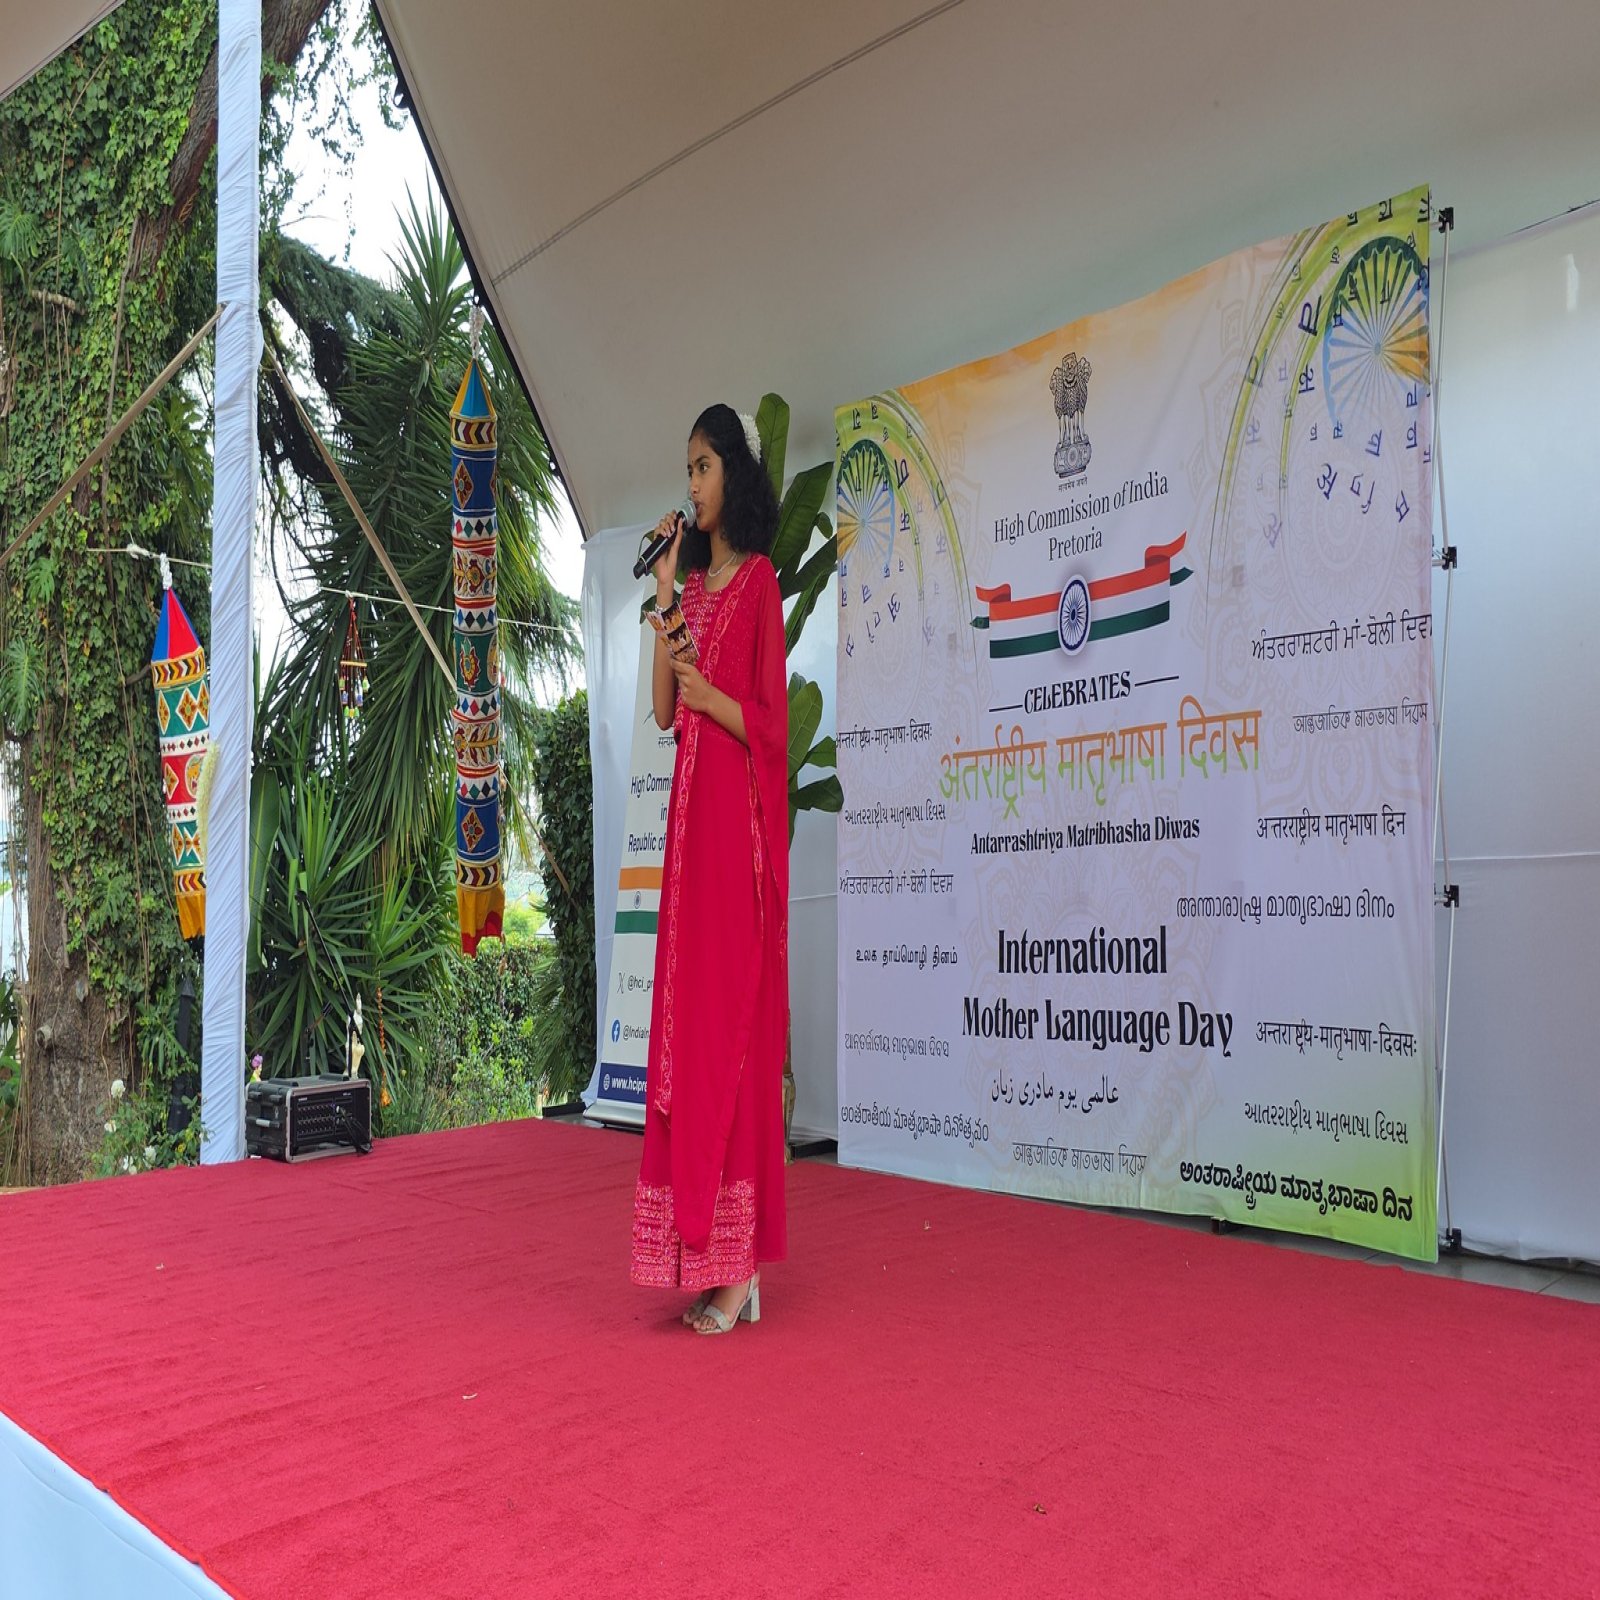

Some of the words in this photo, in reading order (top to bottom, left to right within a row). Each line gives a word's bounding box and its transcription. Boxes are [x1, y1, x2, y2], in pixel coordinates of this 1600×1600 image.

[994, 516, 1024, 546] High
[1027, 492, 1110, 534] Commission
[1113, 481, 1129, 508] of
[1128, 471, 1169, 505] India
[1048, 526, 1103, 561] Pretoria
[1400, 608, 1432, 642] ਦਿਵ
[1023, 670, 1131, 714] CELEBRATES
[939, 724, 1047, 819] अंतर्राष्ट्रीय
[1056, 722, 1168, 806] मातृभाषा
[1177, 694, 1262, 780] दिवस
[631, 776, 645, 798] High
[646, 773, 673, 792] Commi
[970, 826, 1063, 855] Antarrashtriya
[1066, 816, 1151, 848] Matribhasha
[1154, 815, 1200, 840] Diwas
[1325, 812, 1377, 845] मातृभाषा
[1382, 804, 1406, 836] दिन
[628, 833, 657, 856] Republic
[1356, 888, 1395, 918] ദിനം
[856, 948, 877, 962] உலக
[882, 944, 927, 971] தாய்மொழி
[932, 945, 958, 970] தினம்
[998, 925, 1167, 975] International
[628, 975, 654, 992] @hci_pr
[623, 1025, 650, 1041] @IndiaIn
[962, 997, 1040, 1039] Mother
[1045, 999, 1170, 1053] Language
[1177, 1001, 1233, 1057] Day
[611, 1076, 648, 1095] www.hcipre
[1382, 1186, 1413, 1221] ದಿನ
